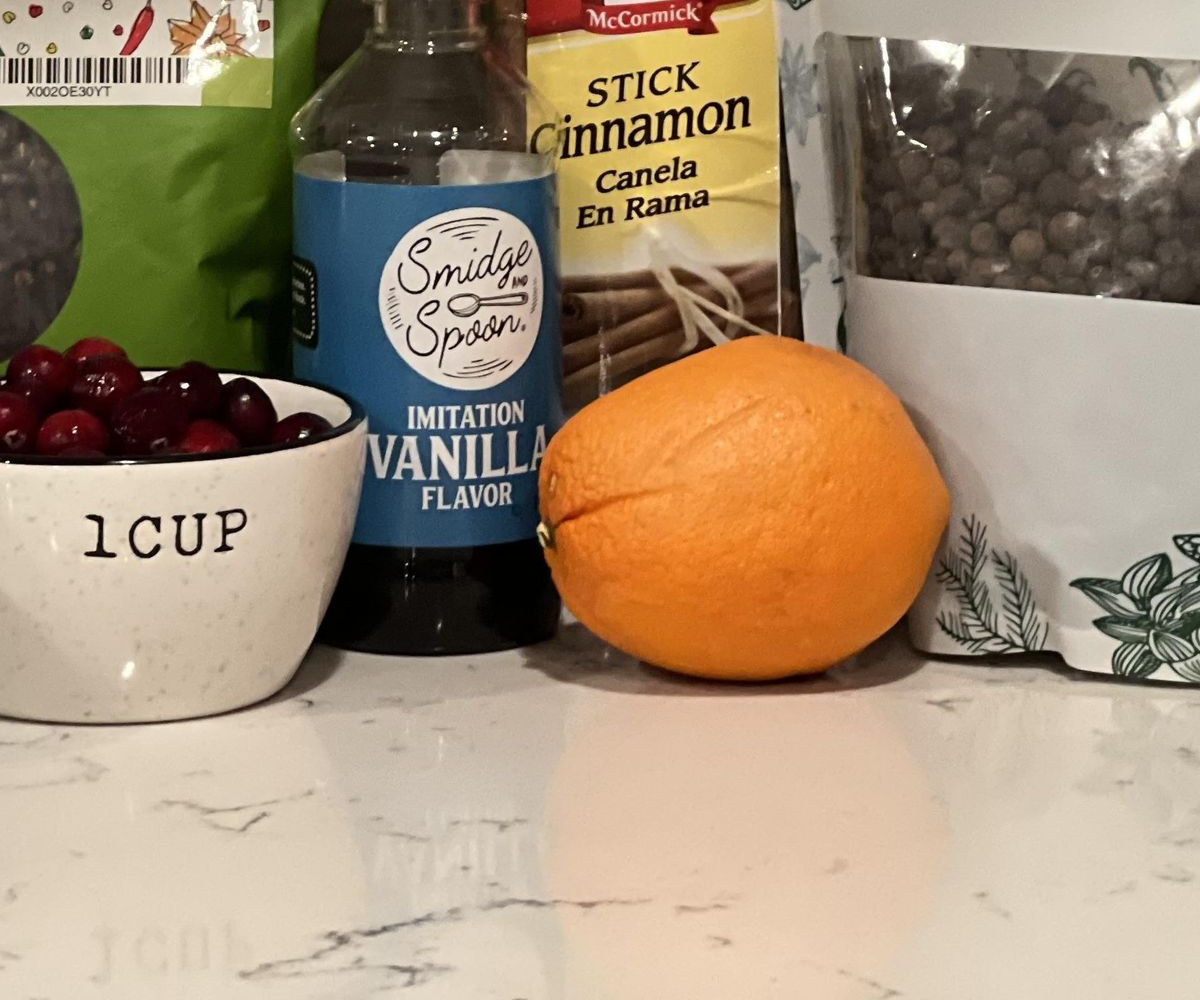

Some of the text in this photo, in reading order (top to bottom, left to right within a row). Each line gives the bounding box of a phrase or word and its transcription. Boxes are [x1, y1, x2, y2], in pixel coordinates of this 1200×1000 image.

[586, 2, 701, 29] McCormick
[586, 60, 700, 107] STICK
[530, 94, 752, 160] Cinnamon
[596, 156, 698, 194] Canela
[576, 188, 710, 230] En Rama
[398, 229, 533, 295] Smidge
[407, 399, 525, 430] IMITATION
[367, 423, 548, 481] VANILLA
[421, 482, 513, 511] FLAVOR
